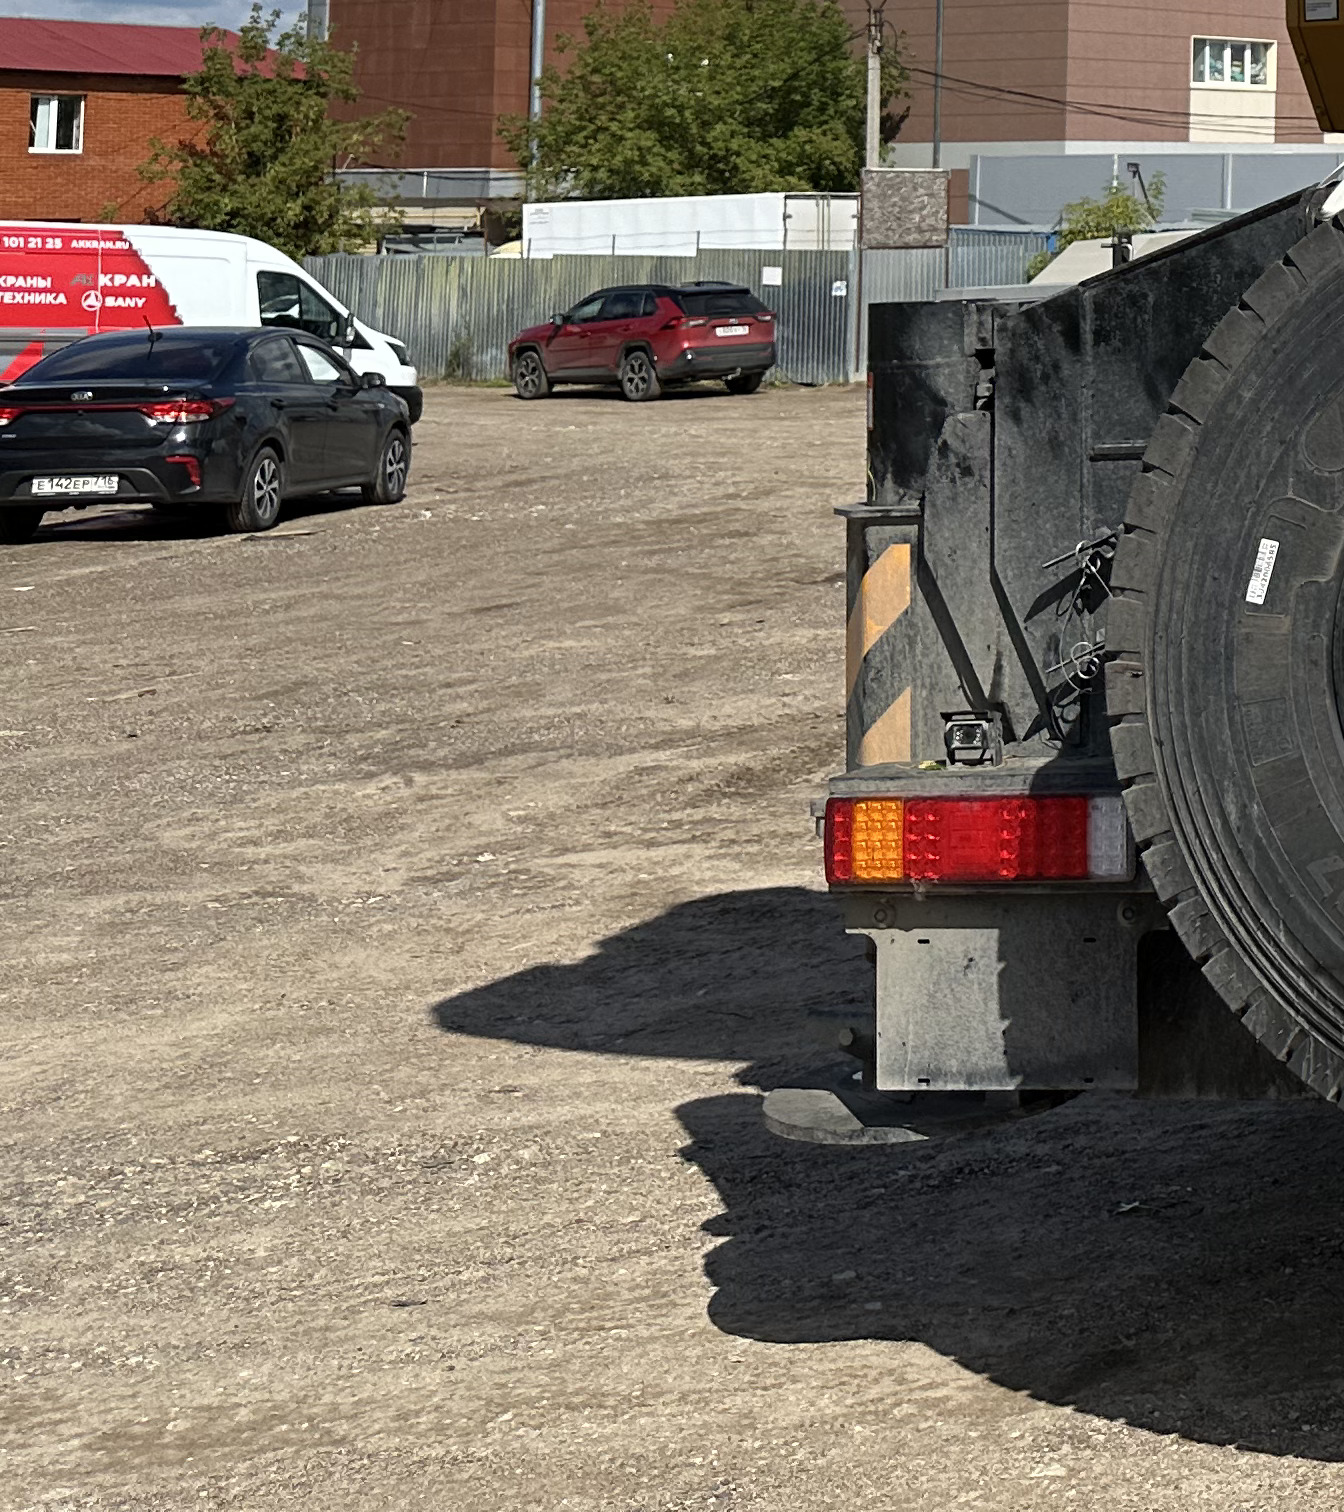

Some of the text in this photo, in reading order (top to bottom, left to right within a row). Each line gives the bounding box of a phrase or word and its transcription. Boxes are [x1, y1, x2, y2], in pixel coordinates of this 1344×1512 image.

[3, 236, 25, 248] 101
[27, 237, 42, 248] 21
[45, 238, 62, 249] 25
[99, 273, 156, 287] КРАН
[104, 296, 147, 308] SANY
